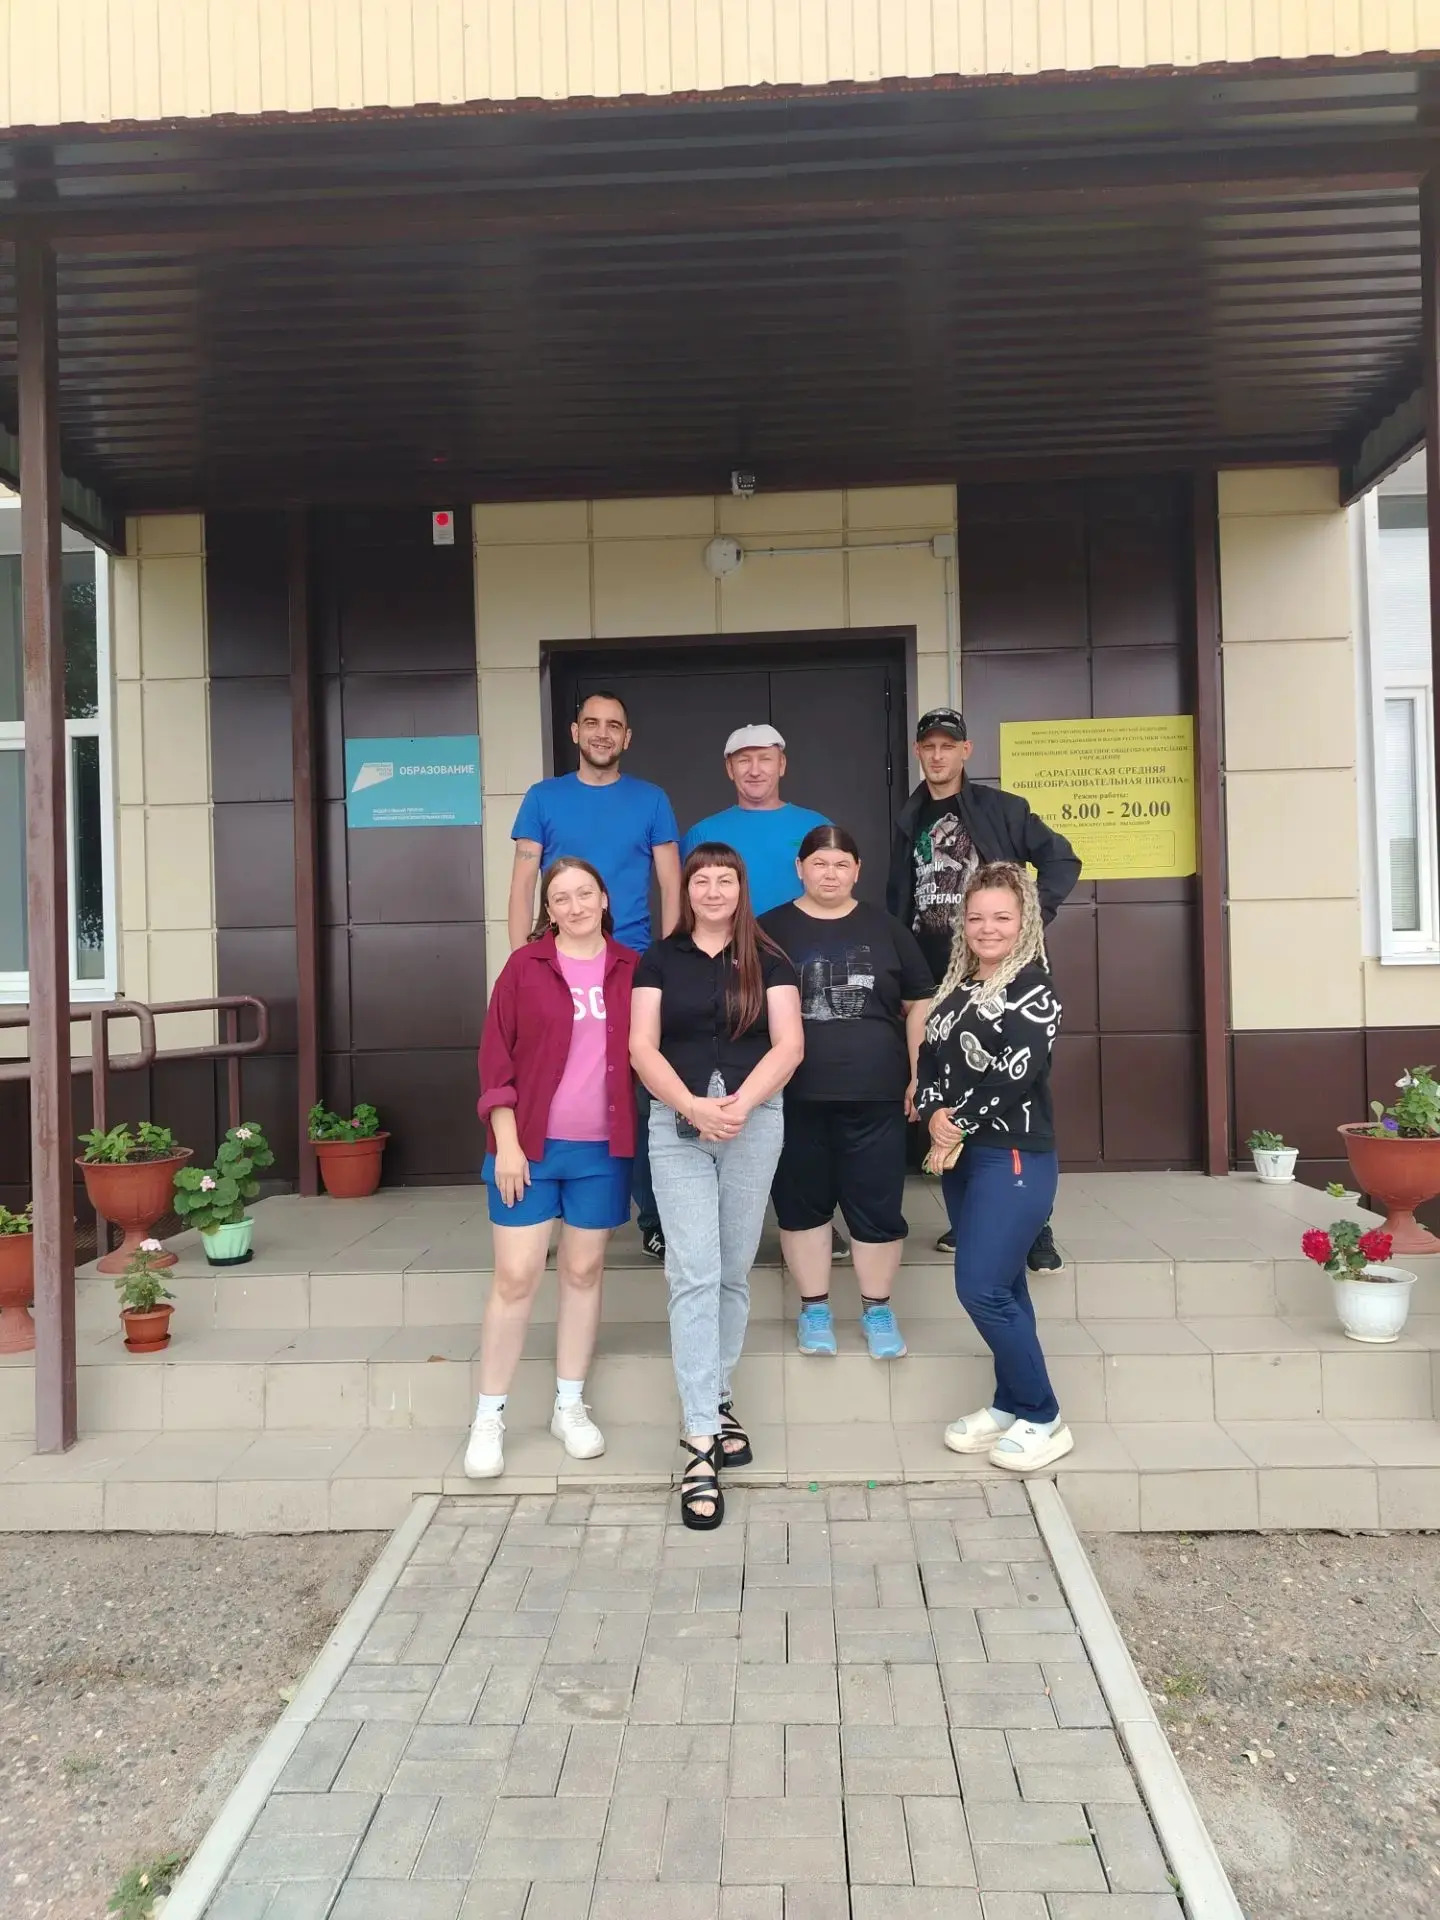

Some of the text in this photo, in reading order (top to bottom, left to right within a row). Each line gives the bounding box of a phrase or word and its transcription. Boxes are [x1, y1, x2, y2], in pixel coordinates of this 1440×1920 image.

[399, 764, 475, 776] ОБРАЗОВАНИЕ
[1118, 765, 1166, 775] СРЕДНЯЯ
[1012, 777, 1142, 789] ОБЩЕОБРАЗОВАТЕЛЬНАЯ
[1073, 791, 1129, 800] Режим работы:
[1061, 802, 1101, 820] 8.00
[1120, 800, 1171, 818] 20.00
